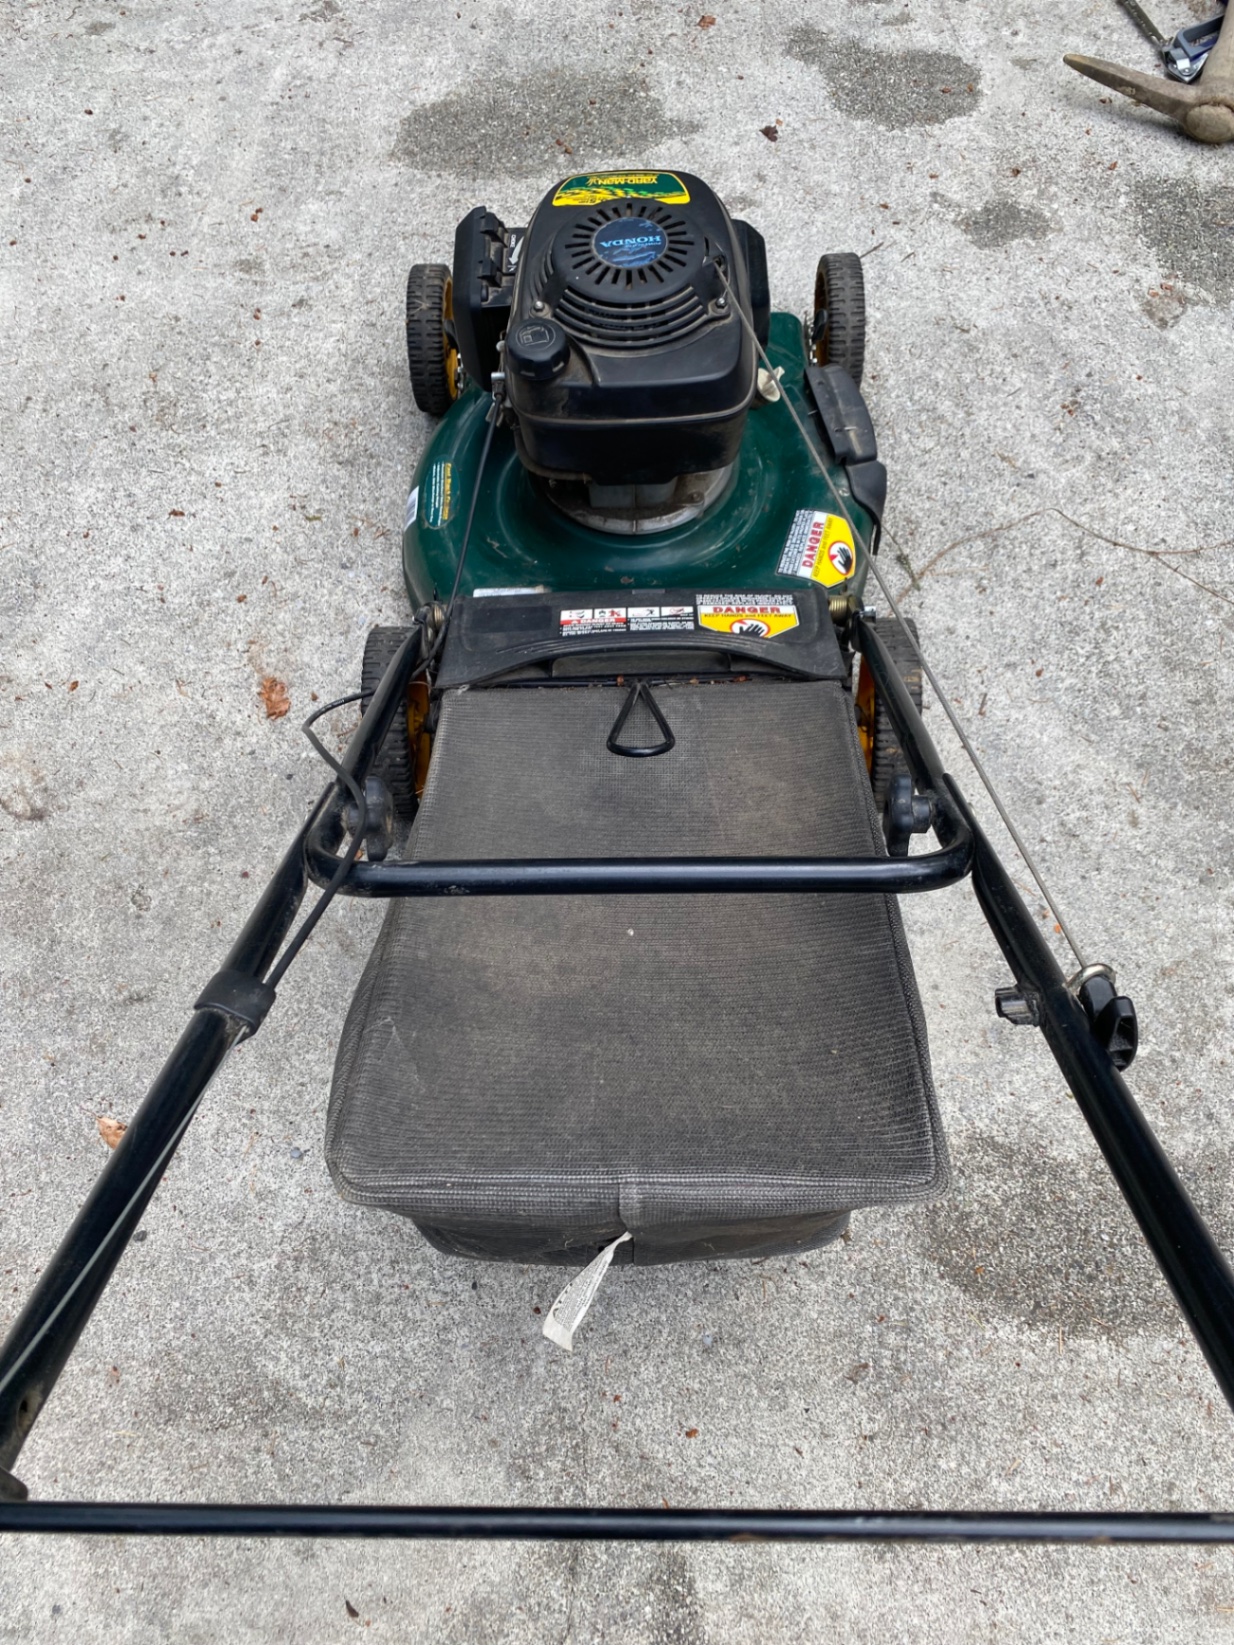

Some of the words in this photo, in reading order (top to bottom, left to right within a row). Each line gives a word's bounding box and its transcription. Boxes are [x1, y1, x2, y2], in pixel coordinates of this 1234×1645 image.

[600, 235, 661, 248] HONDA
[802, 521, 825, 568] DANGER
[817, 550, 825, 566] HANDS
[823, 530, 831, 541] FEET
[712, 606, 781, 614] DANGER
